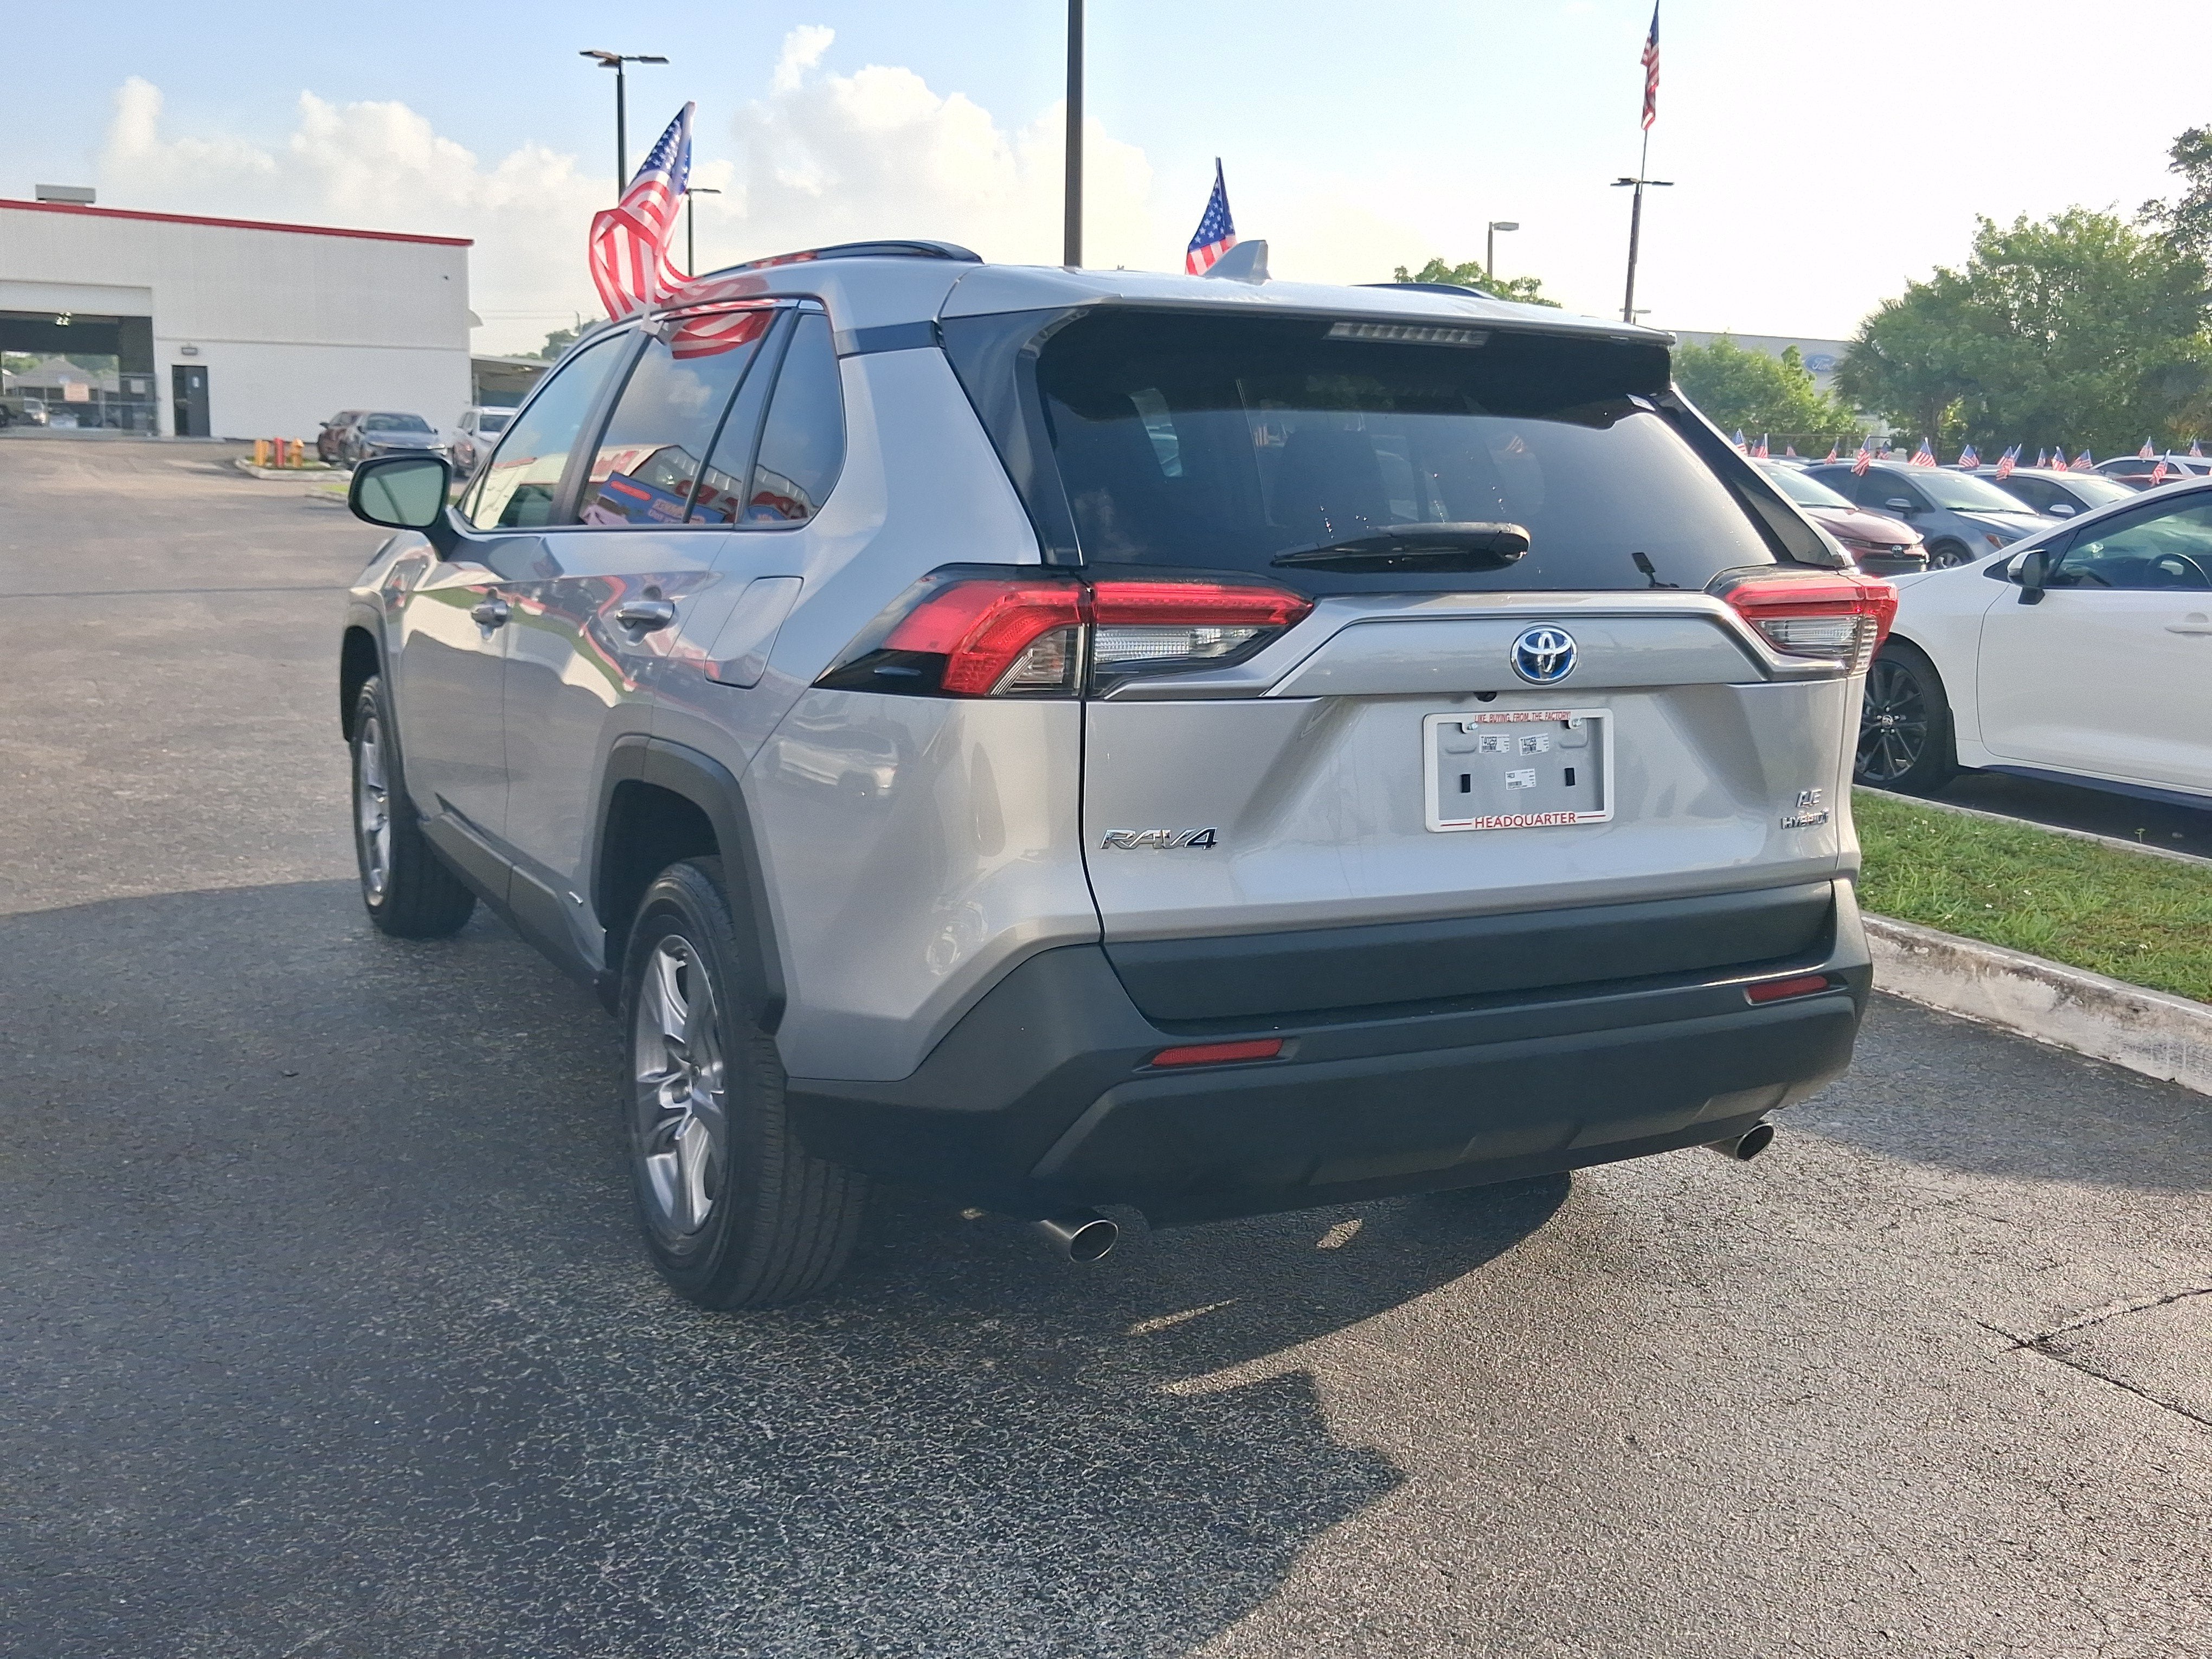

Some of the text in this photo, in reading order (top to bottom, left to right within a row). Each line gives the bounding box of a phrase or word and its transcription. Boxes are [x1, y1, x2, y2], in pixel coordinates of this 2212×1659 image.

[1475, 714, 1487, 723] LIKE
[1489, 713, 1510, 723] BUYING
[1513, 712, 1531, 722] FROM
[1532, 712, 1542, 722] THE
[1475, 813, 1576, 828] HEADQUARTER
[1099, 827, 1218, 850] RAV4
